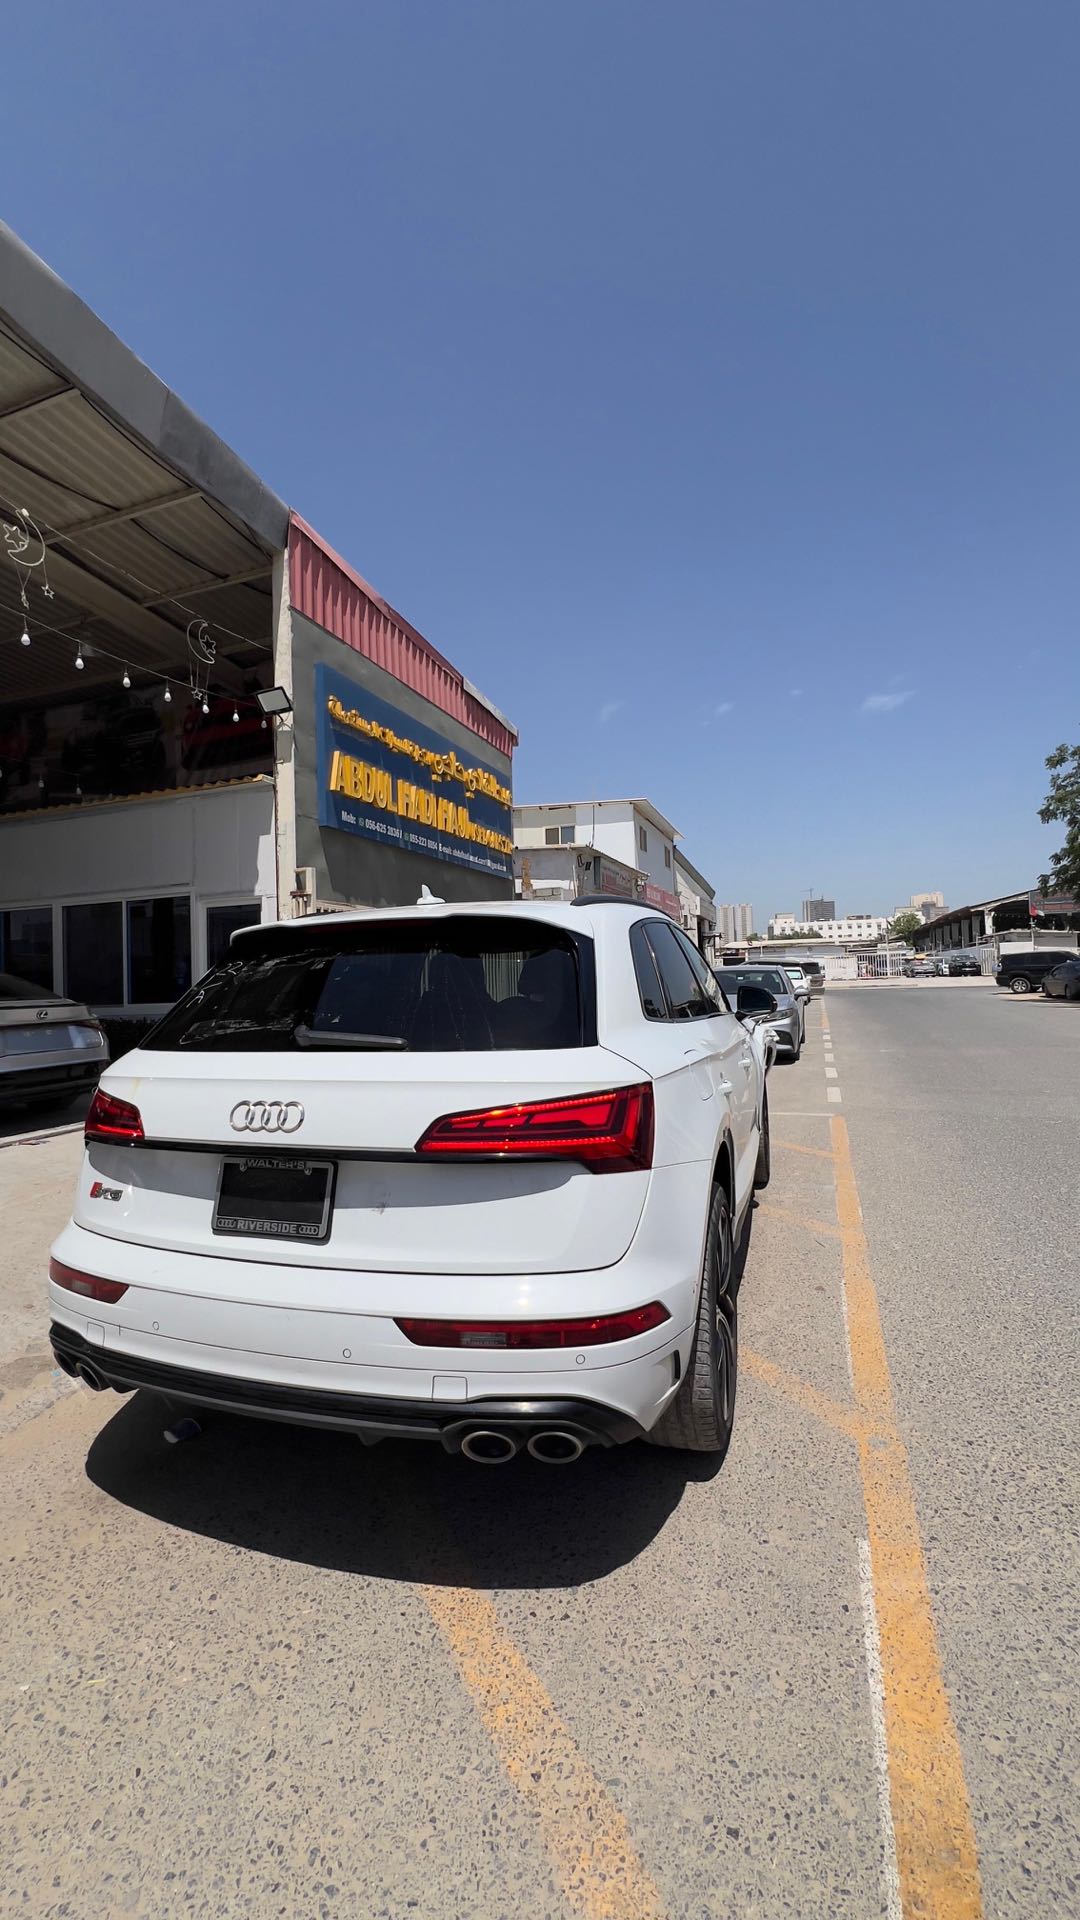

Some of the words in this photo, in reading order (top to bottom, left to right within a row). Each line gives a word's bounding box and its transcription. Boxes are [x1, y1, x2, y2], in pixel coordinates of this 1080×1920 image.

[329, 750, 398, 813] ABDUL
[397, 778, 438, 828] HADI
[247, 1158, 306, 1170] WALTER'S
[236, 1219, 298, 1234] RIVERSIDE
